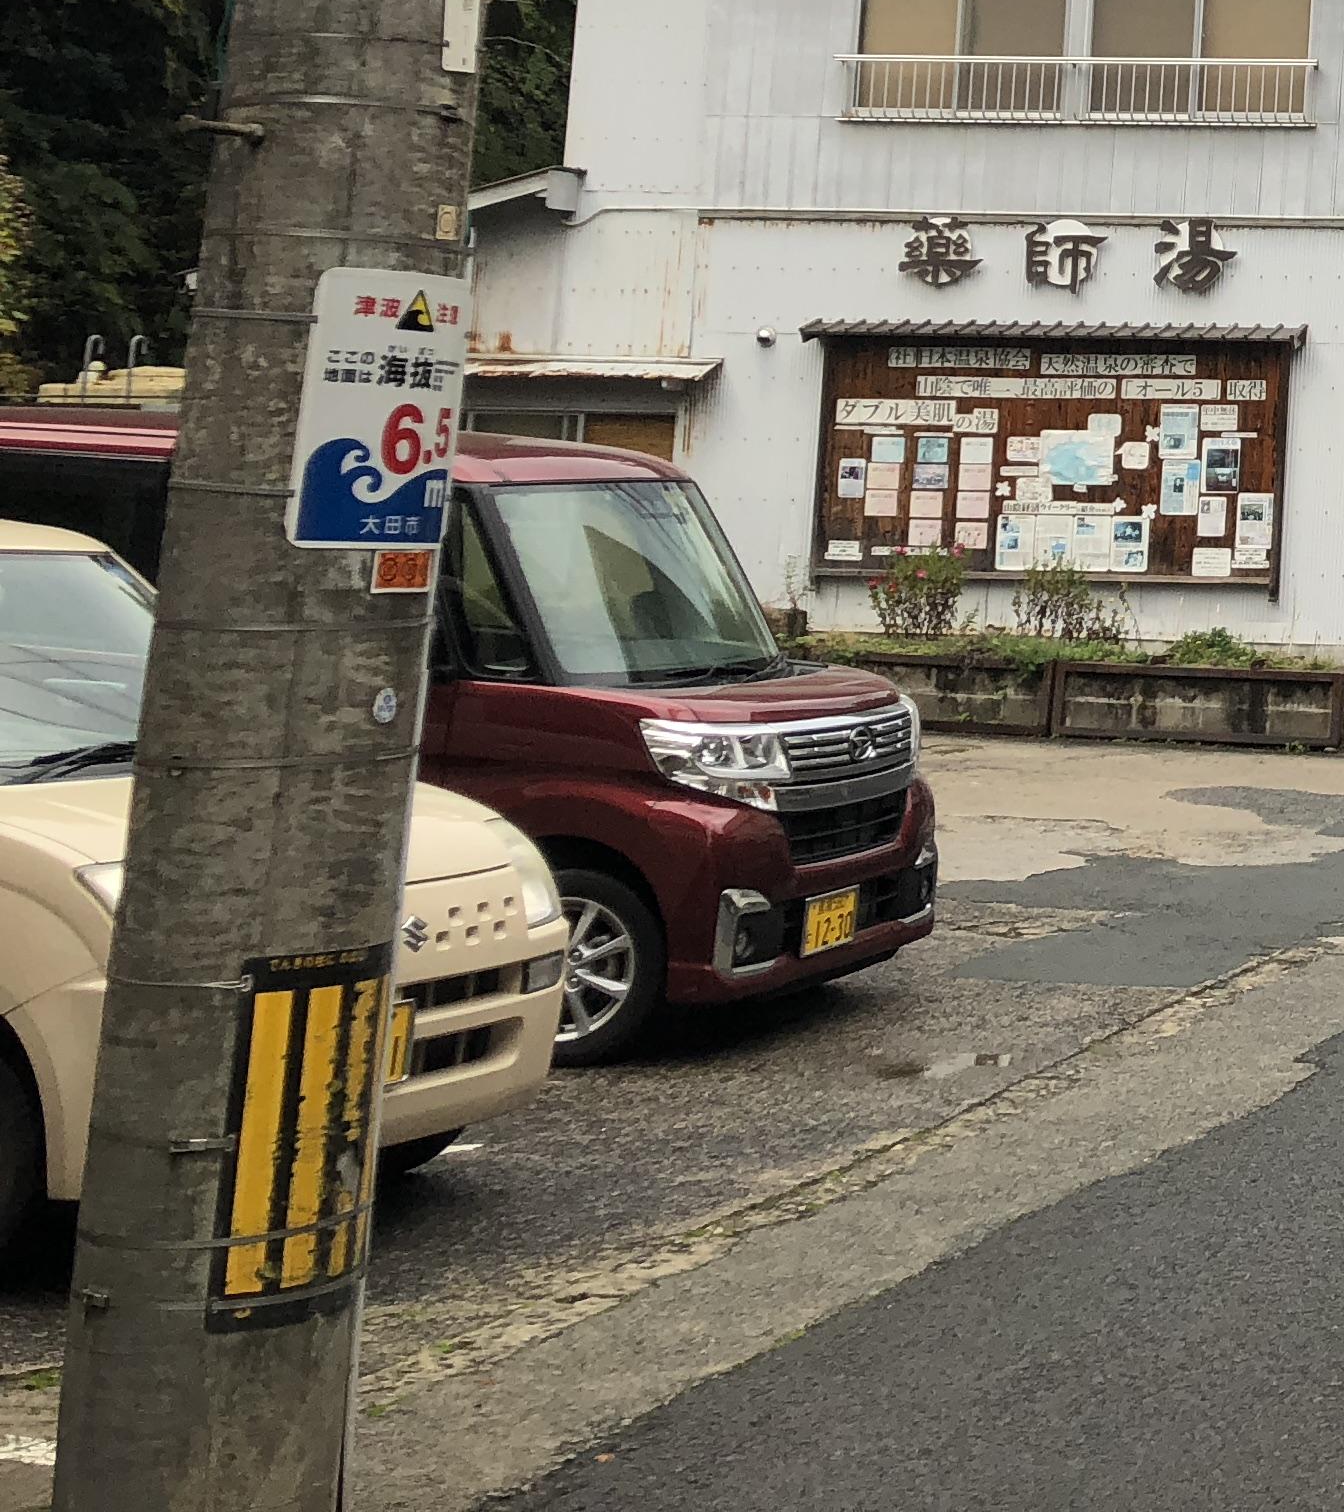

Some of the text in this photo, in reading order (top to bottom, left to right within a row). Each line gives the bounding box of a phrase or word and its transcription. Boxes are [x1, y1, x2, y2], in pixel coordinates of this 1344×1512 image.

[353, 295, 401, 319] 津波
[327, 349, 376, 365] ここの
[1043, 355, 1196, 375] 天然温泉の審査で
[376, 354, 434, 390] 海抜
[840, 400, 996, 432] ダブル美肌の湯
[381, 403, 454, 476] 6.5
[359, 514, 422, 536] 大田市
[815, 910, 854, 949] 12-30
